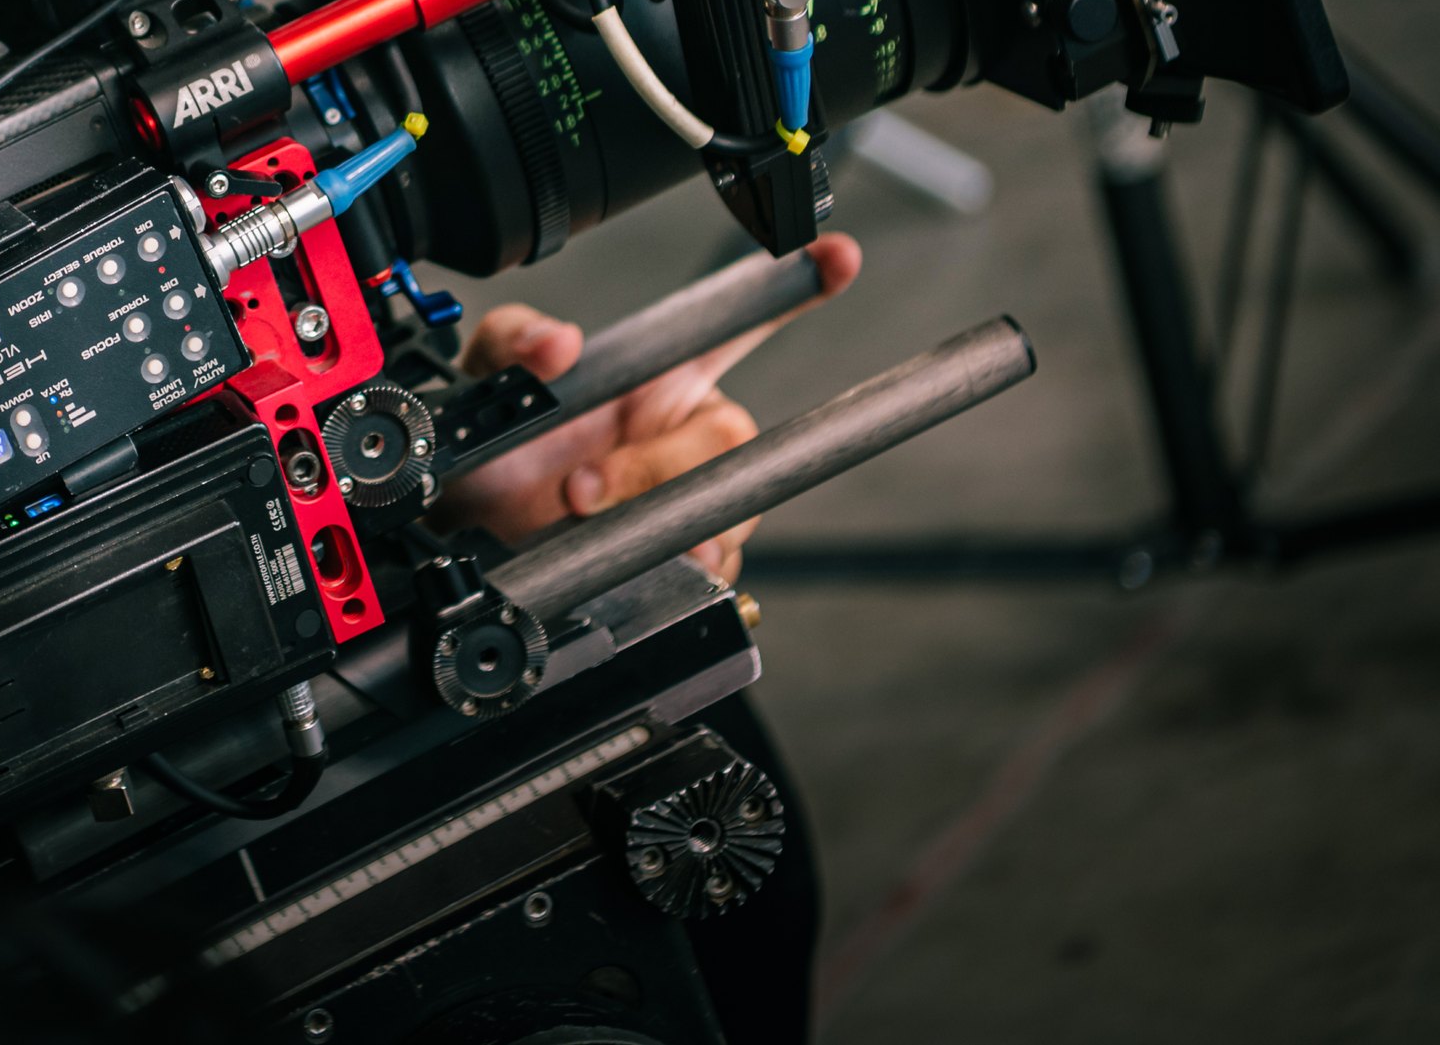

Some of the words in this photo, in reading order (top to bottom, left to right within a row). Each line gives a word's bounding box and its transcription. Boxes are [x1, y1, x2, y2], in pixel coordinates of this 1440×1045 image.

[173, 60, 255, 129] ARRI
[134, 219, 154, 235] DIR
[83, 236, 125, 264] TORQUE
[43, 260, 81, 286] SELECT
[159, 277, 179, 292] DIR
[7, 290, 45, 316] ZOOM
[107, 294, 150, 322] TORQUE
[28, 310, 53, 329] IRIS
[80, 332, 122, 360] FOCUS
[192, 357, 219, 377] MAN
[40, 378, 70, 398] DATA
[148, 377, 183, 401] LIMITS
[152, 387, 187, 411] FOCUS
[0, 388, 34, 413] DOWN
[35, 451, 51, 465] UP
